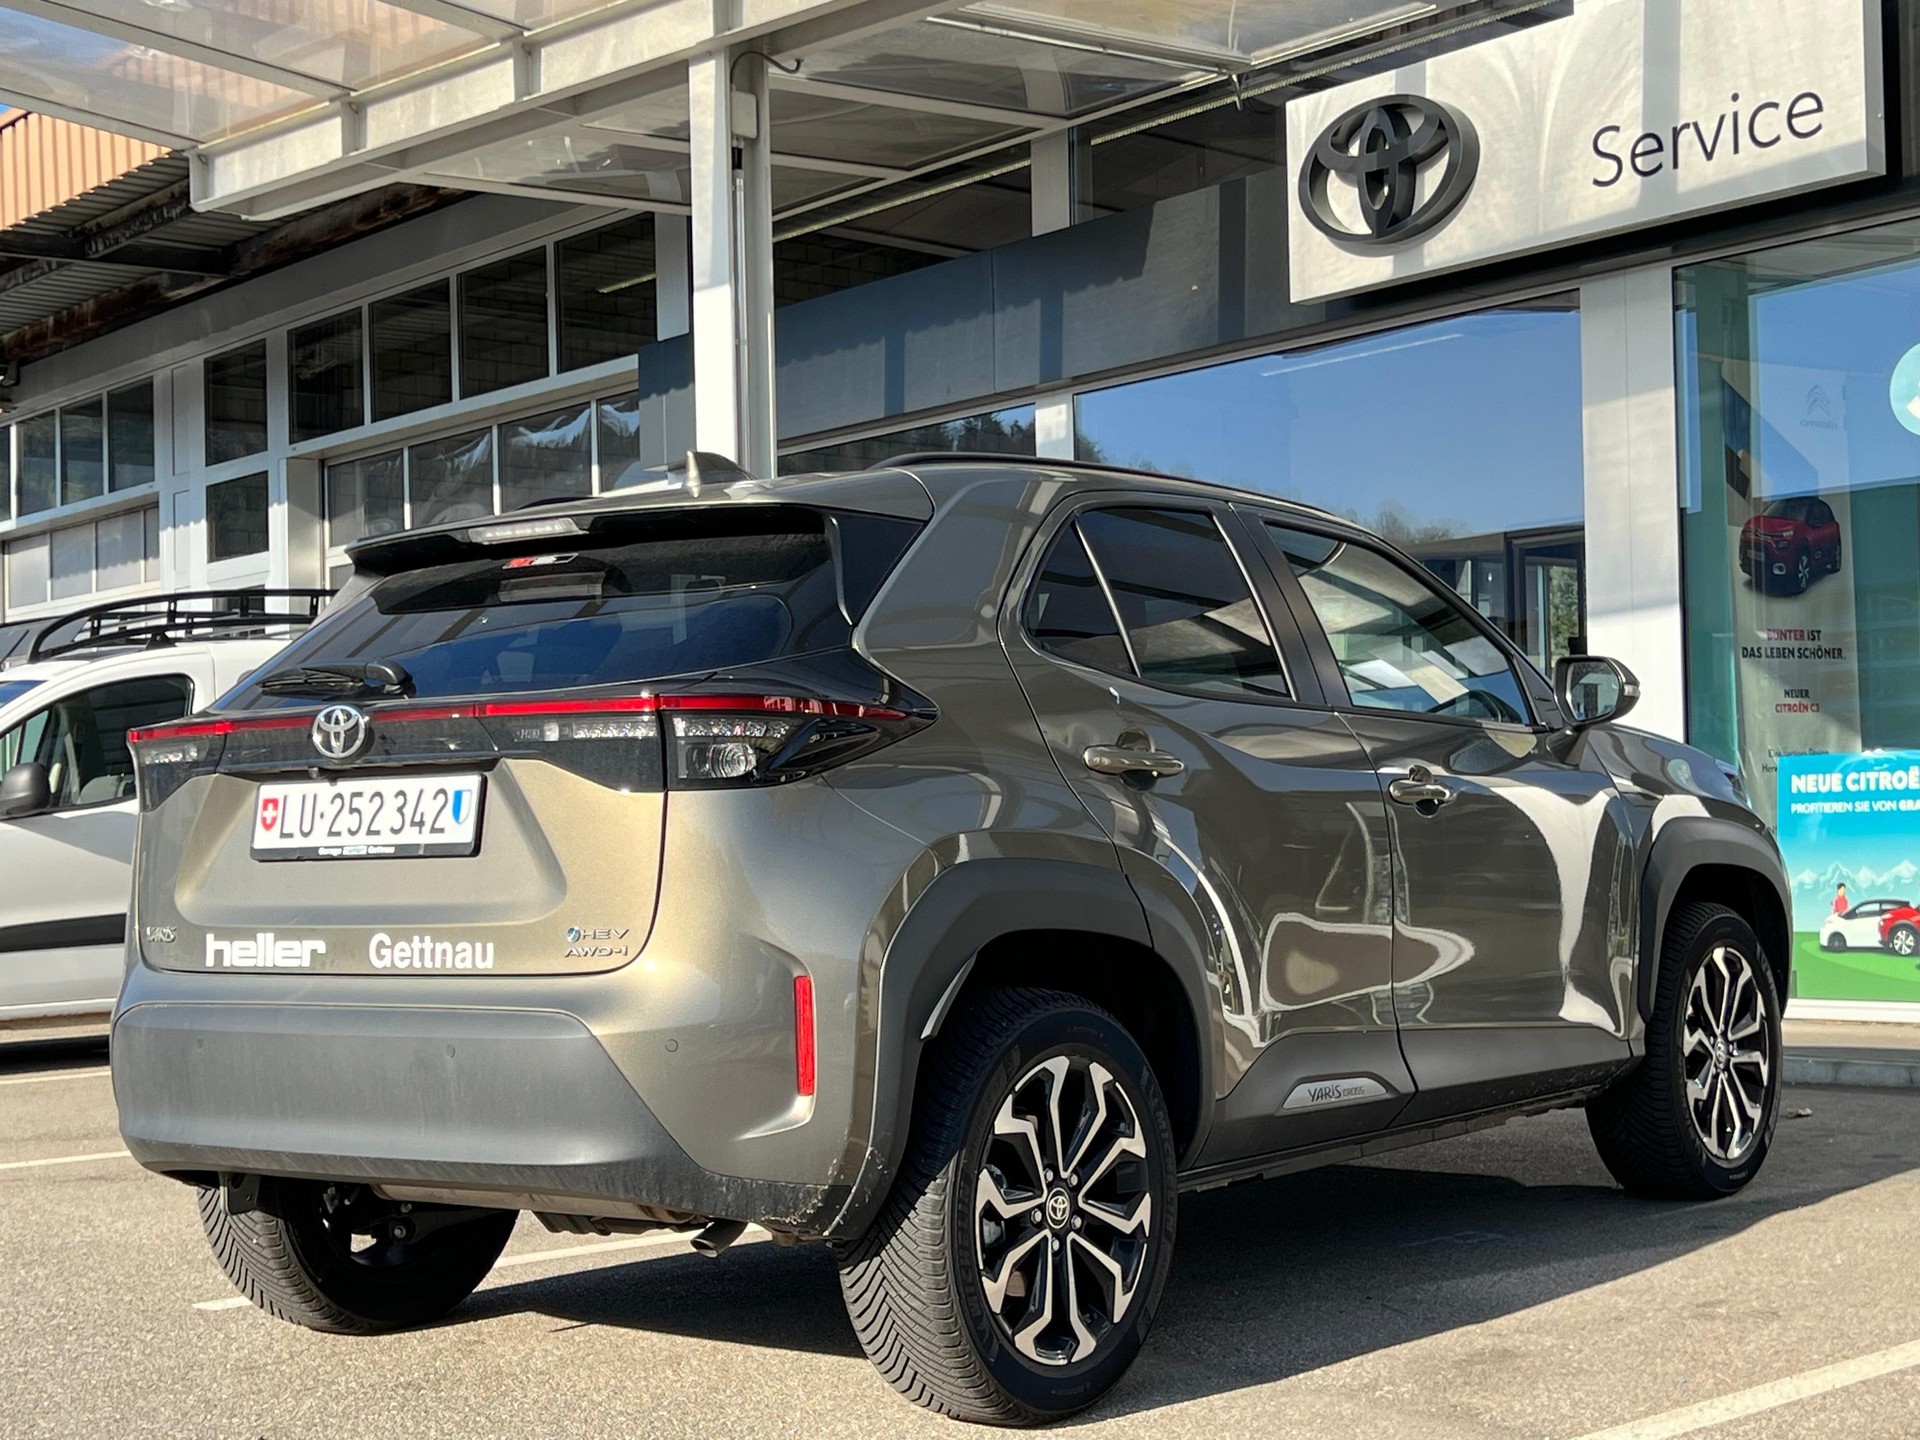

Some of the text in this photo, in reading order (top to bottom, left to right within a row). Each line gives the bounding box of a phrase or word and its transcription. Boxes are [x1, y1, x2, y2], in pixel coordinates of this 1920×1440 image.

[1592, 91, 1824, 187] Service
[1807, 629, 1822, 642] IST
[1741, 646, 1763, 659] DAS
[1765, 646, 1795, 659] LEBEN
[1784, 688, 1810, 699] NEUER
[1775, 701, 1809, 713] CITROËN
[1791, 773, 1844, 794] NEUE
[1790, 802, 1854, 814] PROFITIEREN
[1854, 800, 1871, 812] SIE
[1871, 800, 1897, 812] VON
[583, 928, 630, 940] HEV
[205, 932, 495, 970] heller Gettnau
[1307, 1084, 1342, 1103] YARIS
